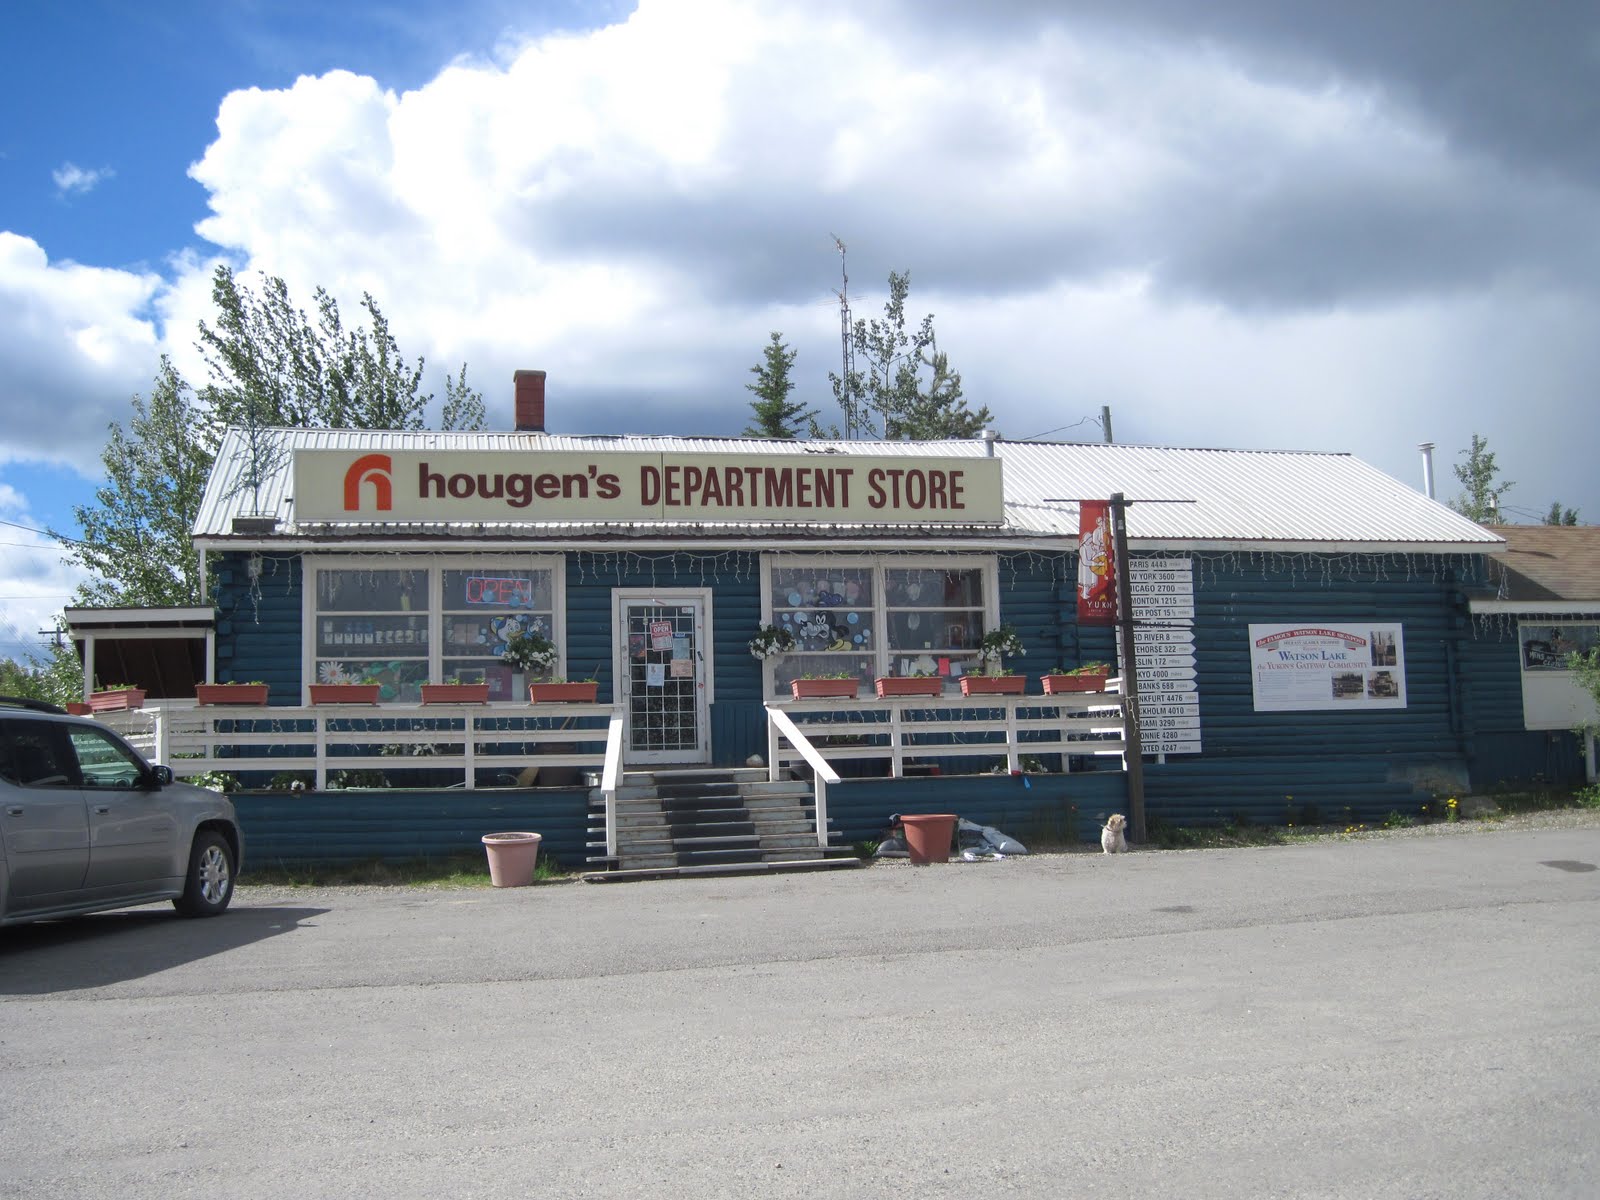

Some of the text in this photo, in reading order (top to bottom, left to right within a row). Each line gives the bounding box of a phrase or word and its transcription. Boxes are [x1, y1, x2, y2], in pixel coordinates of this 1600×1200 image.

[419, 462, 965, 510] hougen's DEPARTMENT STORE
[1267, 633, 1291, 642] FAMOUS
[1279, 650, 1347, 661] WATSON LAKE
[1328, 661, 1367, 669] COMMUNITY
[1159, 719, 1175, 727] 3290
